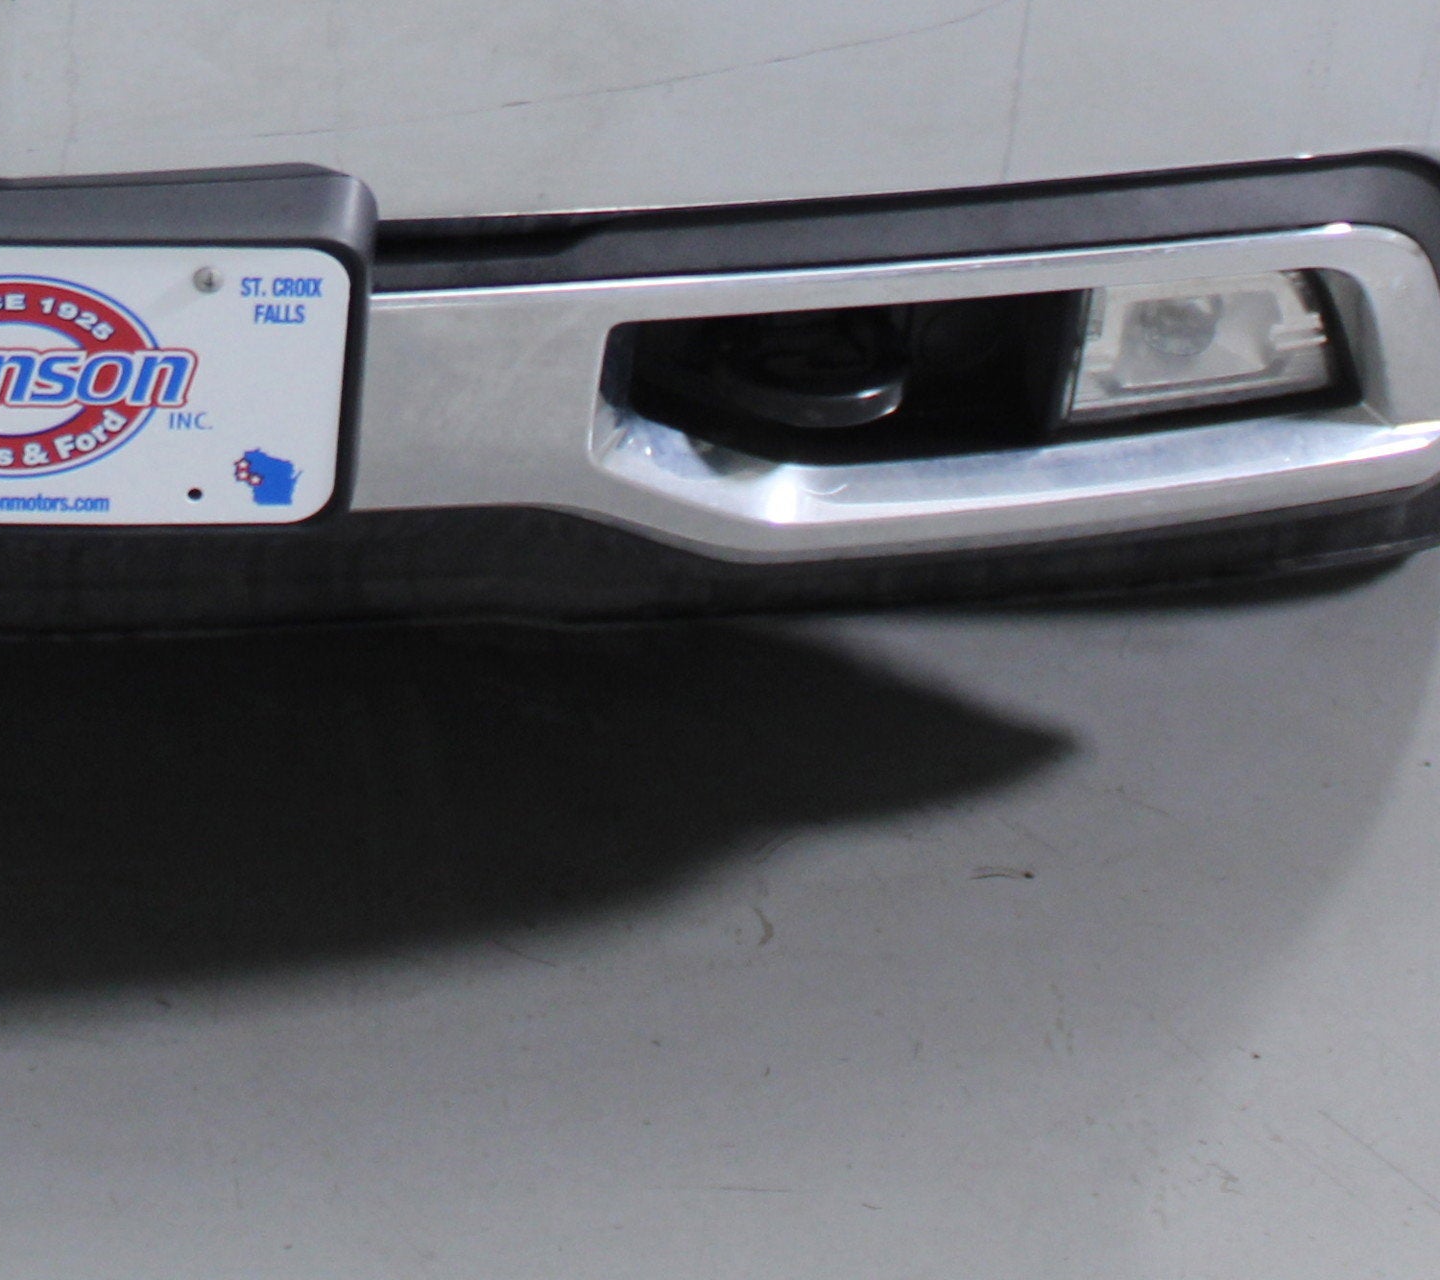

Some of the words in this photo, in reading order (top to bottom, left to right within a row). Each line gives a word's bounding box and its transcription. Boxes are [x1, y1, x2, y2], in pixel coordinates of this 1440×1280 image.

[240, 277, 267, 297] ST.
[272, 277, 324, 297] CROIX
[39, 297, 117, 341] 1925
[253, 304, 306, 324] FALLS
[168, 412, 213, 431] INC.
[22, 442, 50, 466] &
[54, 408, 128, 461] Ford
